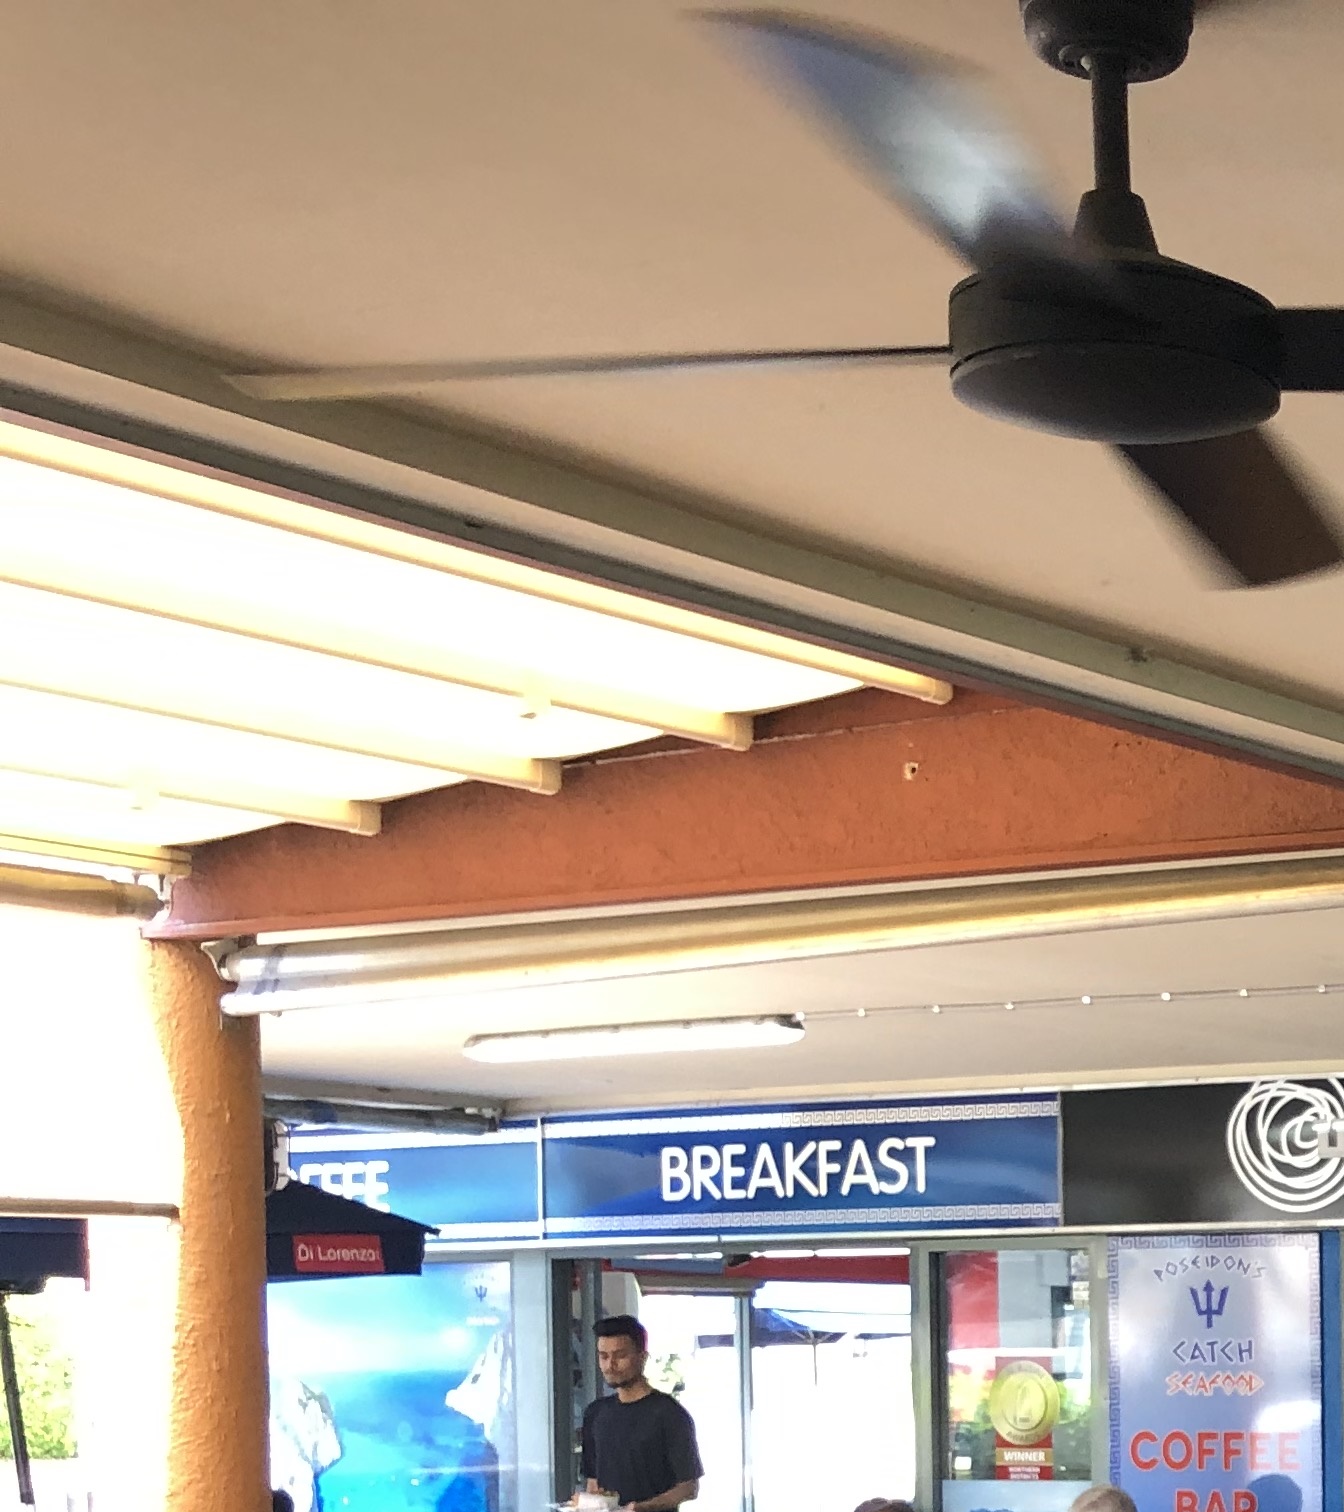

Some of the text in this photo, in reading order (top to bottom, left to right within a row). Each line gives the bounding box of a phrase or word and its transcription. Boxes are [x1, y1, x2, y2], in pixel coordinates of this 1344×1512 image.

[660, 1136, 937, 1202] BREAKFAST
[297, 1243, 314, 1262] Di
[1153, 1254, 1268, 1283] POSEIDON'S
[1172, 1338, 1255, 1365] CATCH
[1164, 1370, 1265, 1396] SEAFOOD
[1003, 1450, 1046, 1462] WINNER
[1129, 1428, 1303, 1473] COFFEE
